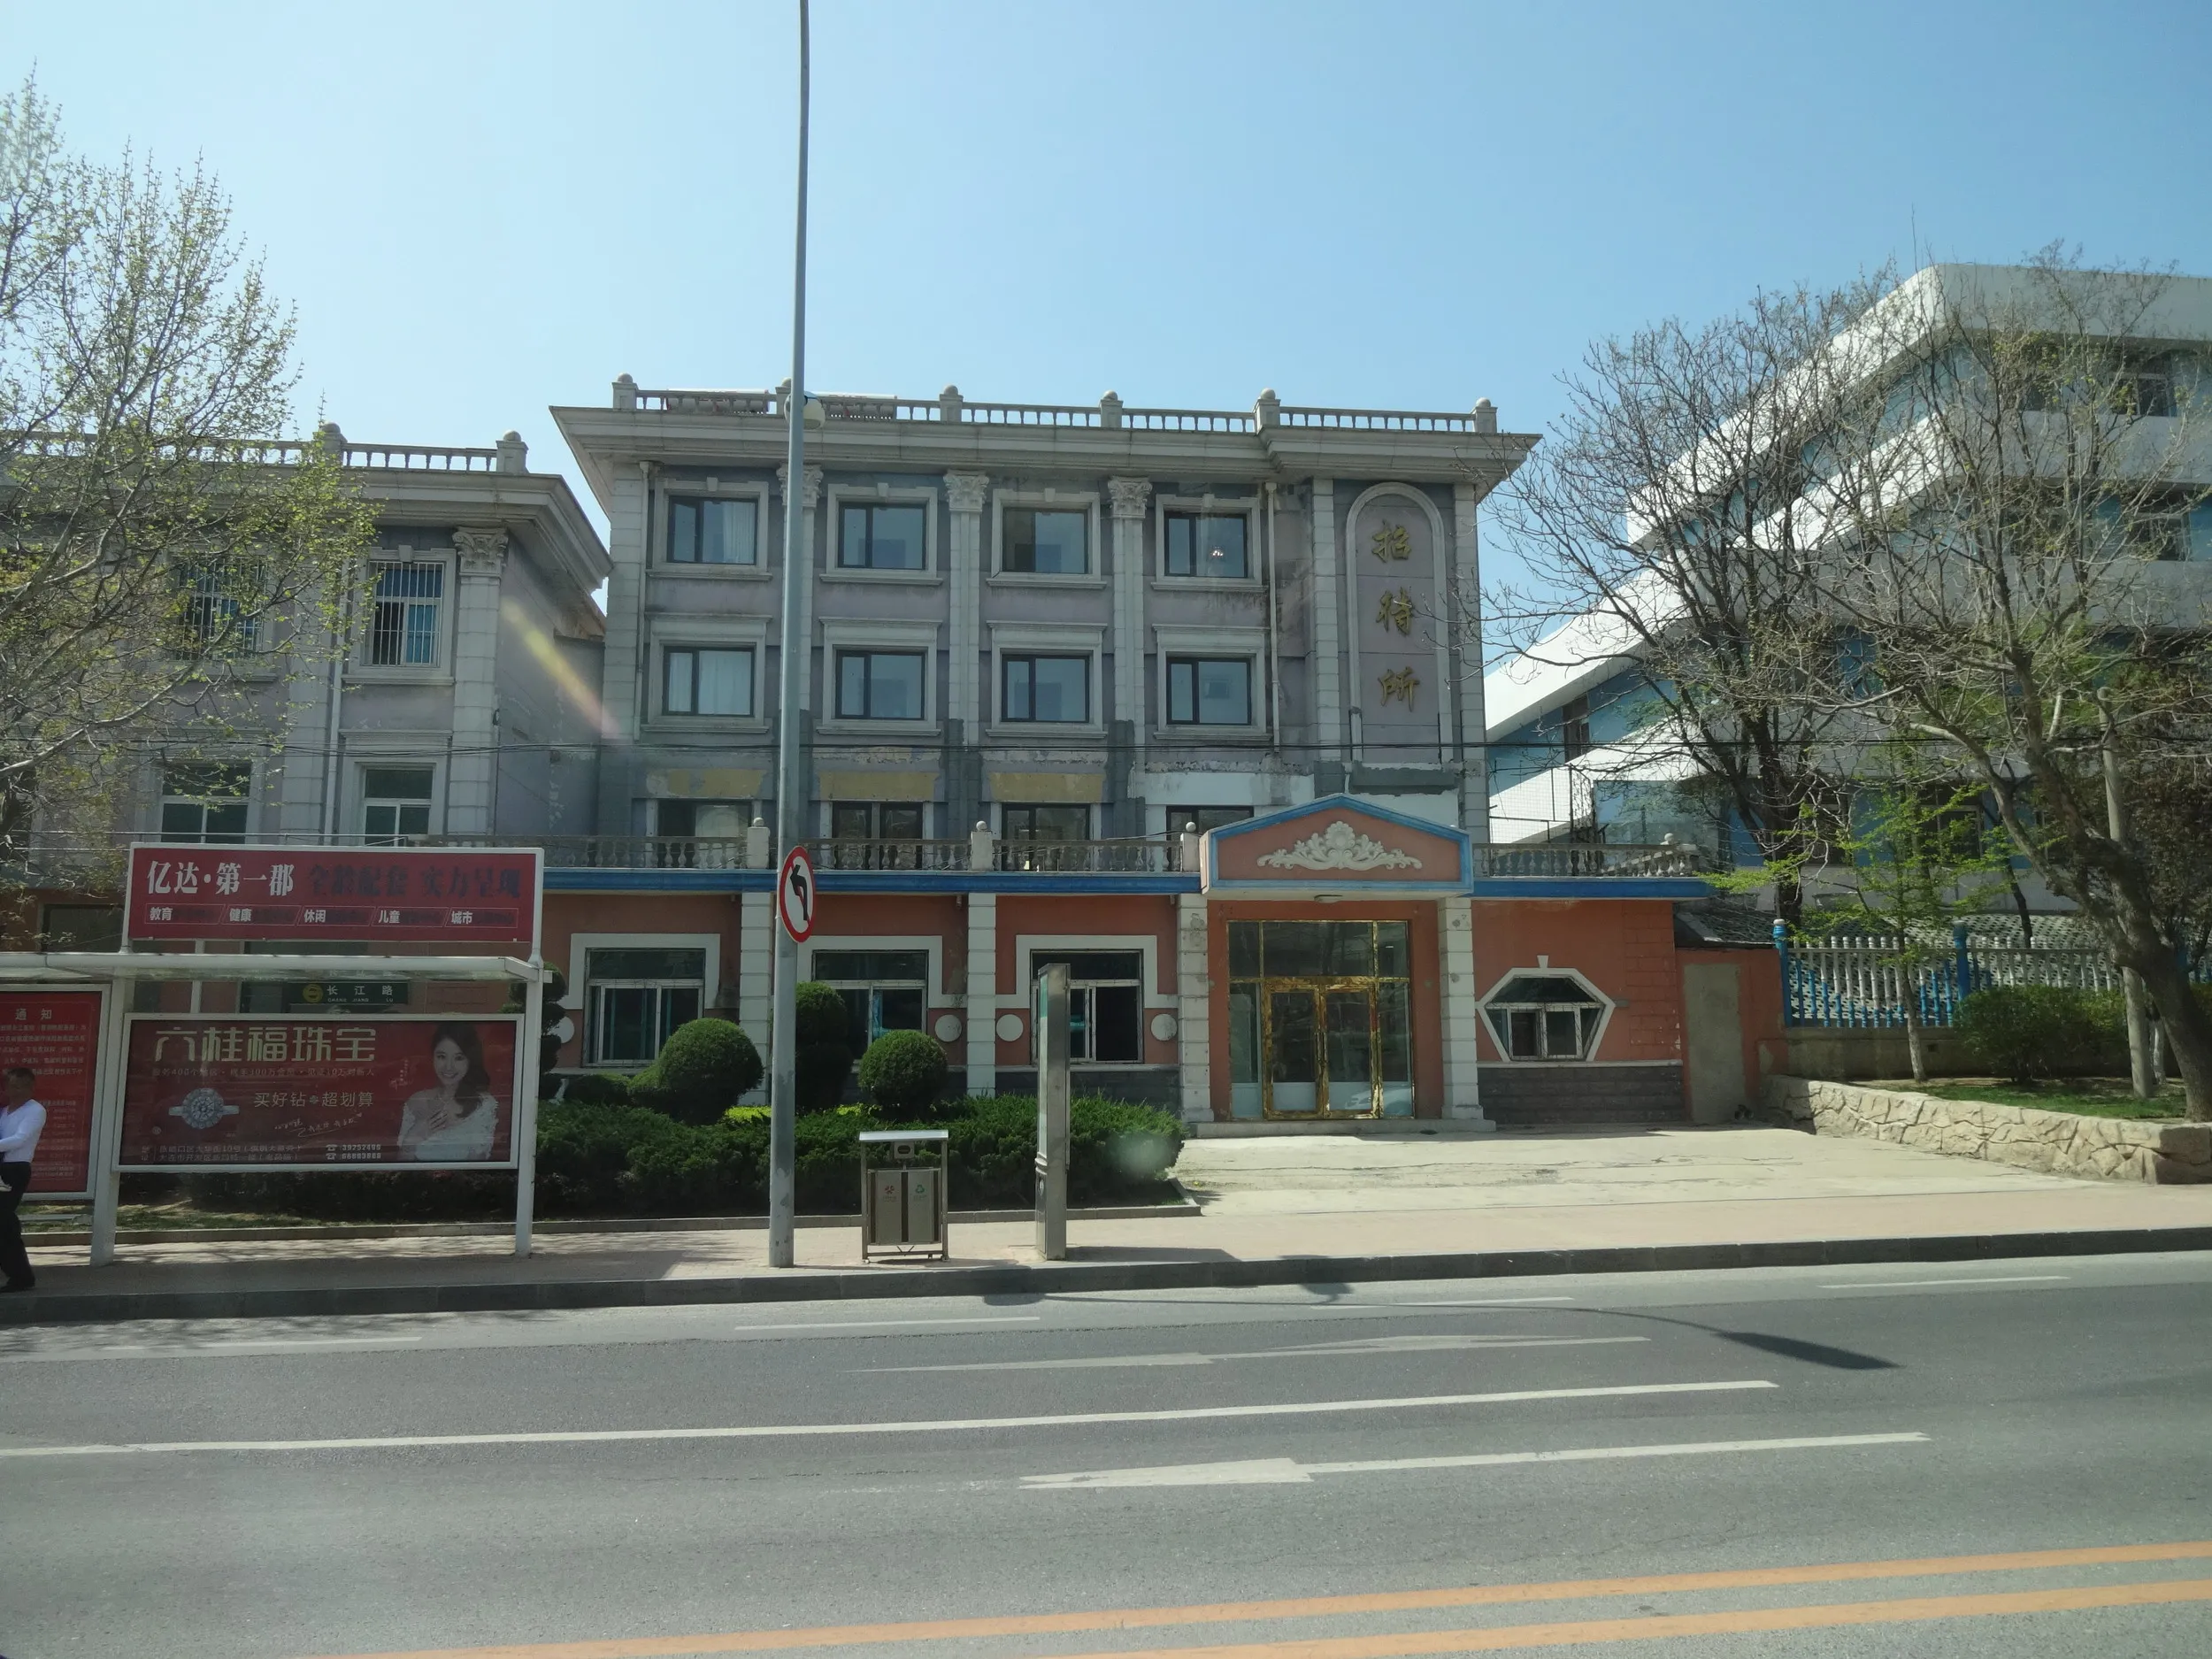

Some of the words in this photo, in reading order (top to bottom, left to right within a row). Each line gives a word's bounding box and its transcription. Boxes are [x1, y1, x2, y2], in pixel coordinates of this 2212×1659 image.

[1371, 518, 1419, 712] 招待所
[149, 906, 173, 922] 教育
[228, 907, 252, 923] 健康
[303, 909, 326, 924] 休闲
[378, 910, 401, 925] 儿童
[450, 910, 473, 926] 城市
[326, 984, 394, 996] 长江路
[15, 1008, 52, 1020] 通知
[154, 1025, 377, 1063] 六桂福珠宝
[254, 1091, 307, 1108] 买好钻
[321, 1091, 374, 1108] 超划算
